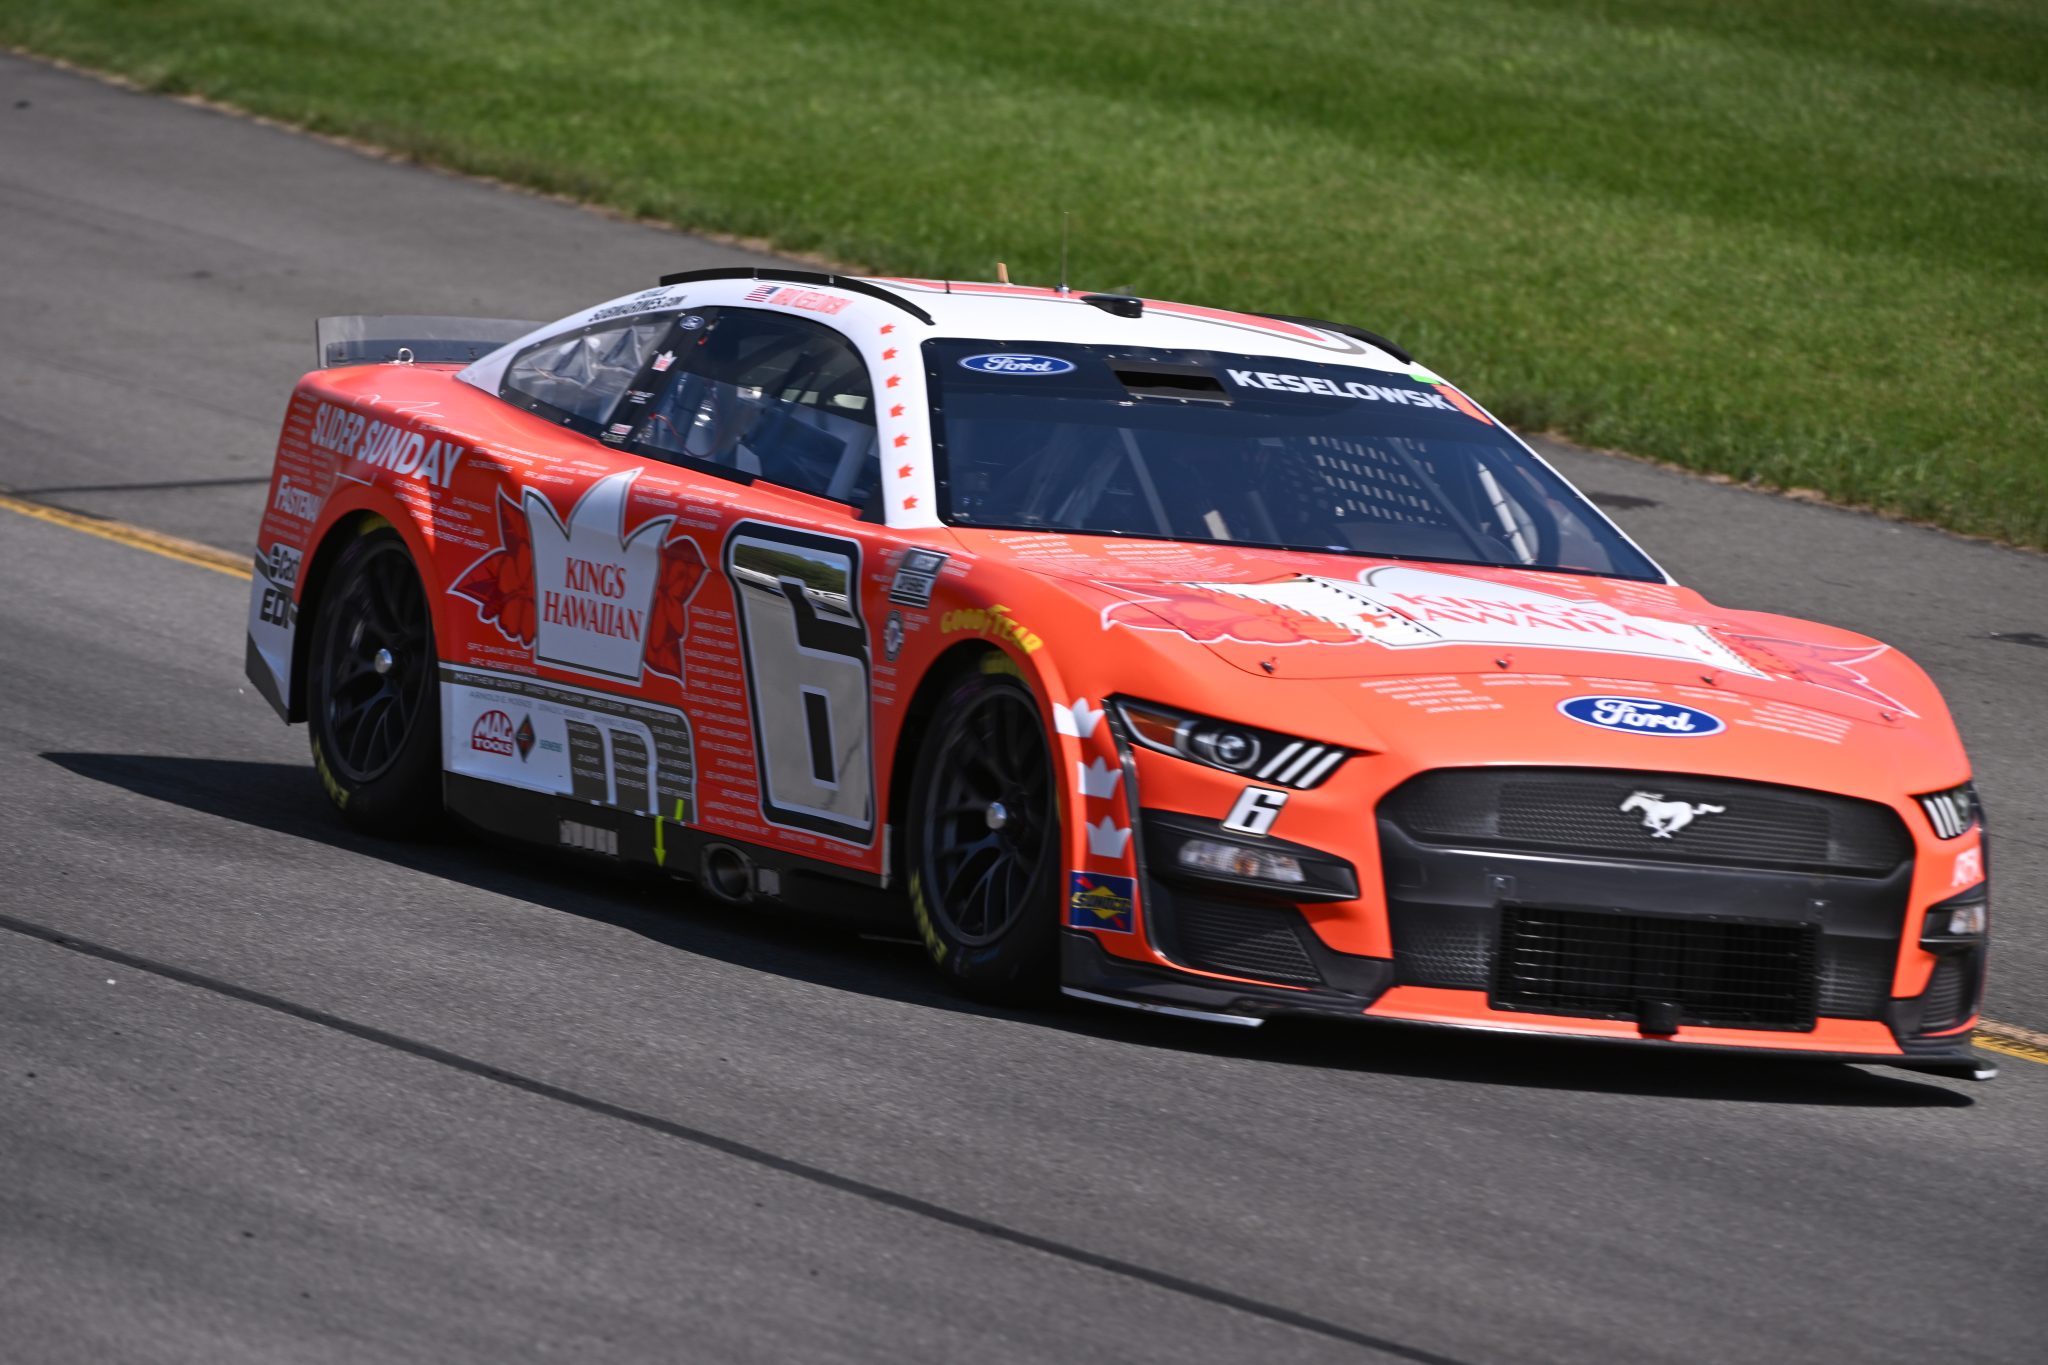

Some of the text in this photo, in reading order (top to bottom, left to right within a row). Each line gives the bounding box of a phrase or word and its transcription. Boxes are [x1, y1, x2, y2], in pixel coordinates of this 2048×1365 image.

[982, 353, 1055, 374] Ford
[1226, 369, 1460, 411] KESELOWSK
[311, 402, 364, 458] SLIDER
[359, 420, 465, 488] SUNDAY
[565, 556, 626, 599] KING'S
[544, 591, 644, 642] HAWAIIAN
[722, 519, 877, 848] 6
[473, 711, 514, 739] MAC
[1592, 698, 1697, 733] Ford
[476, 739, 514, 755] TOOLS
[1220, 785, 1290, 837] 6
